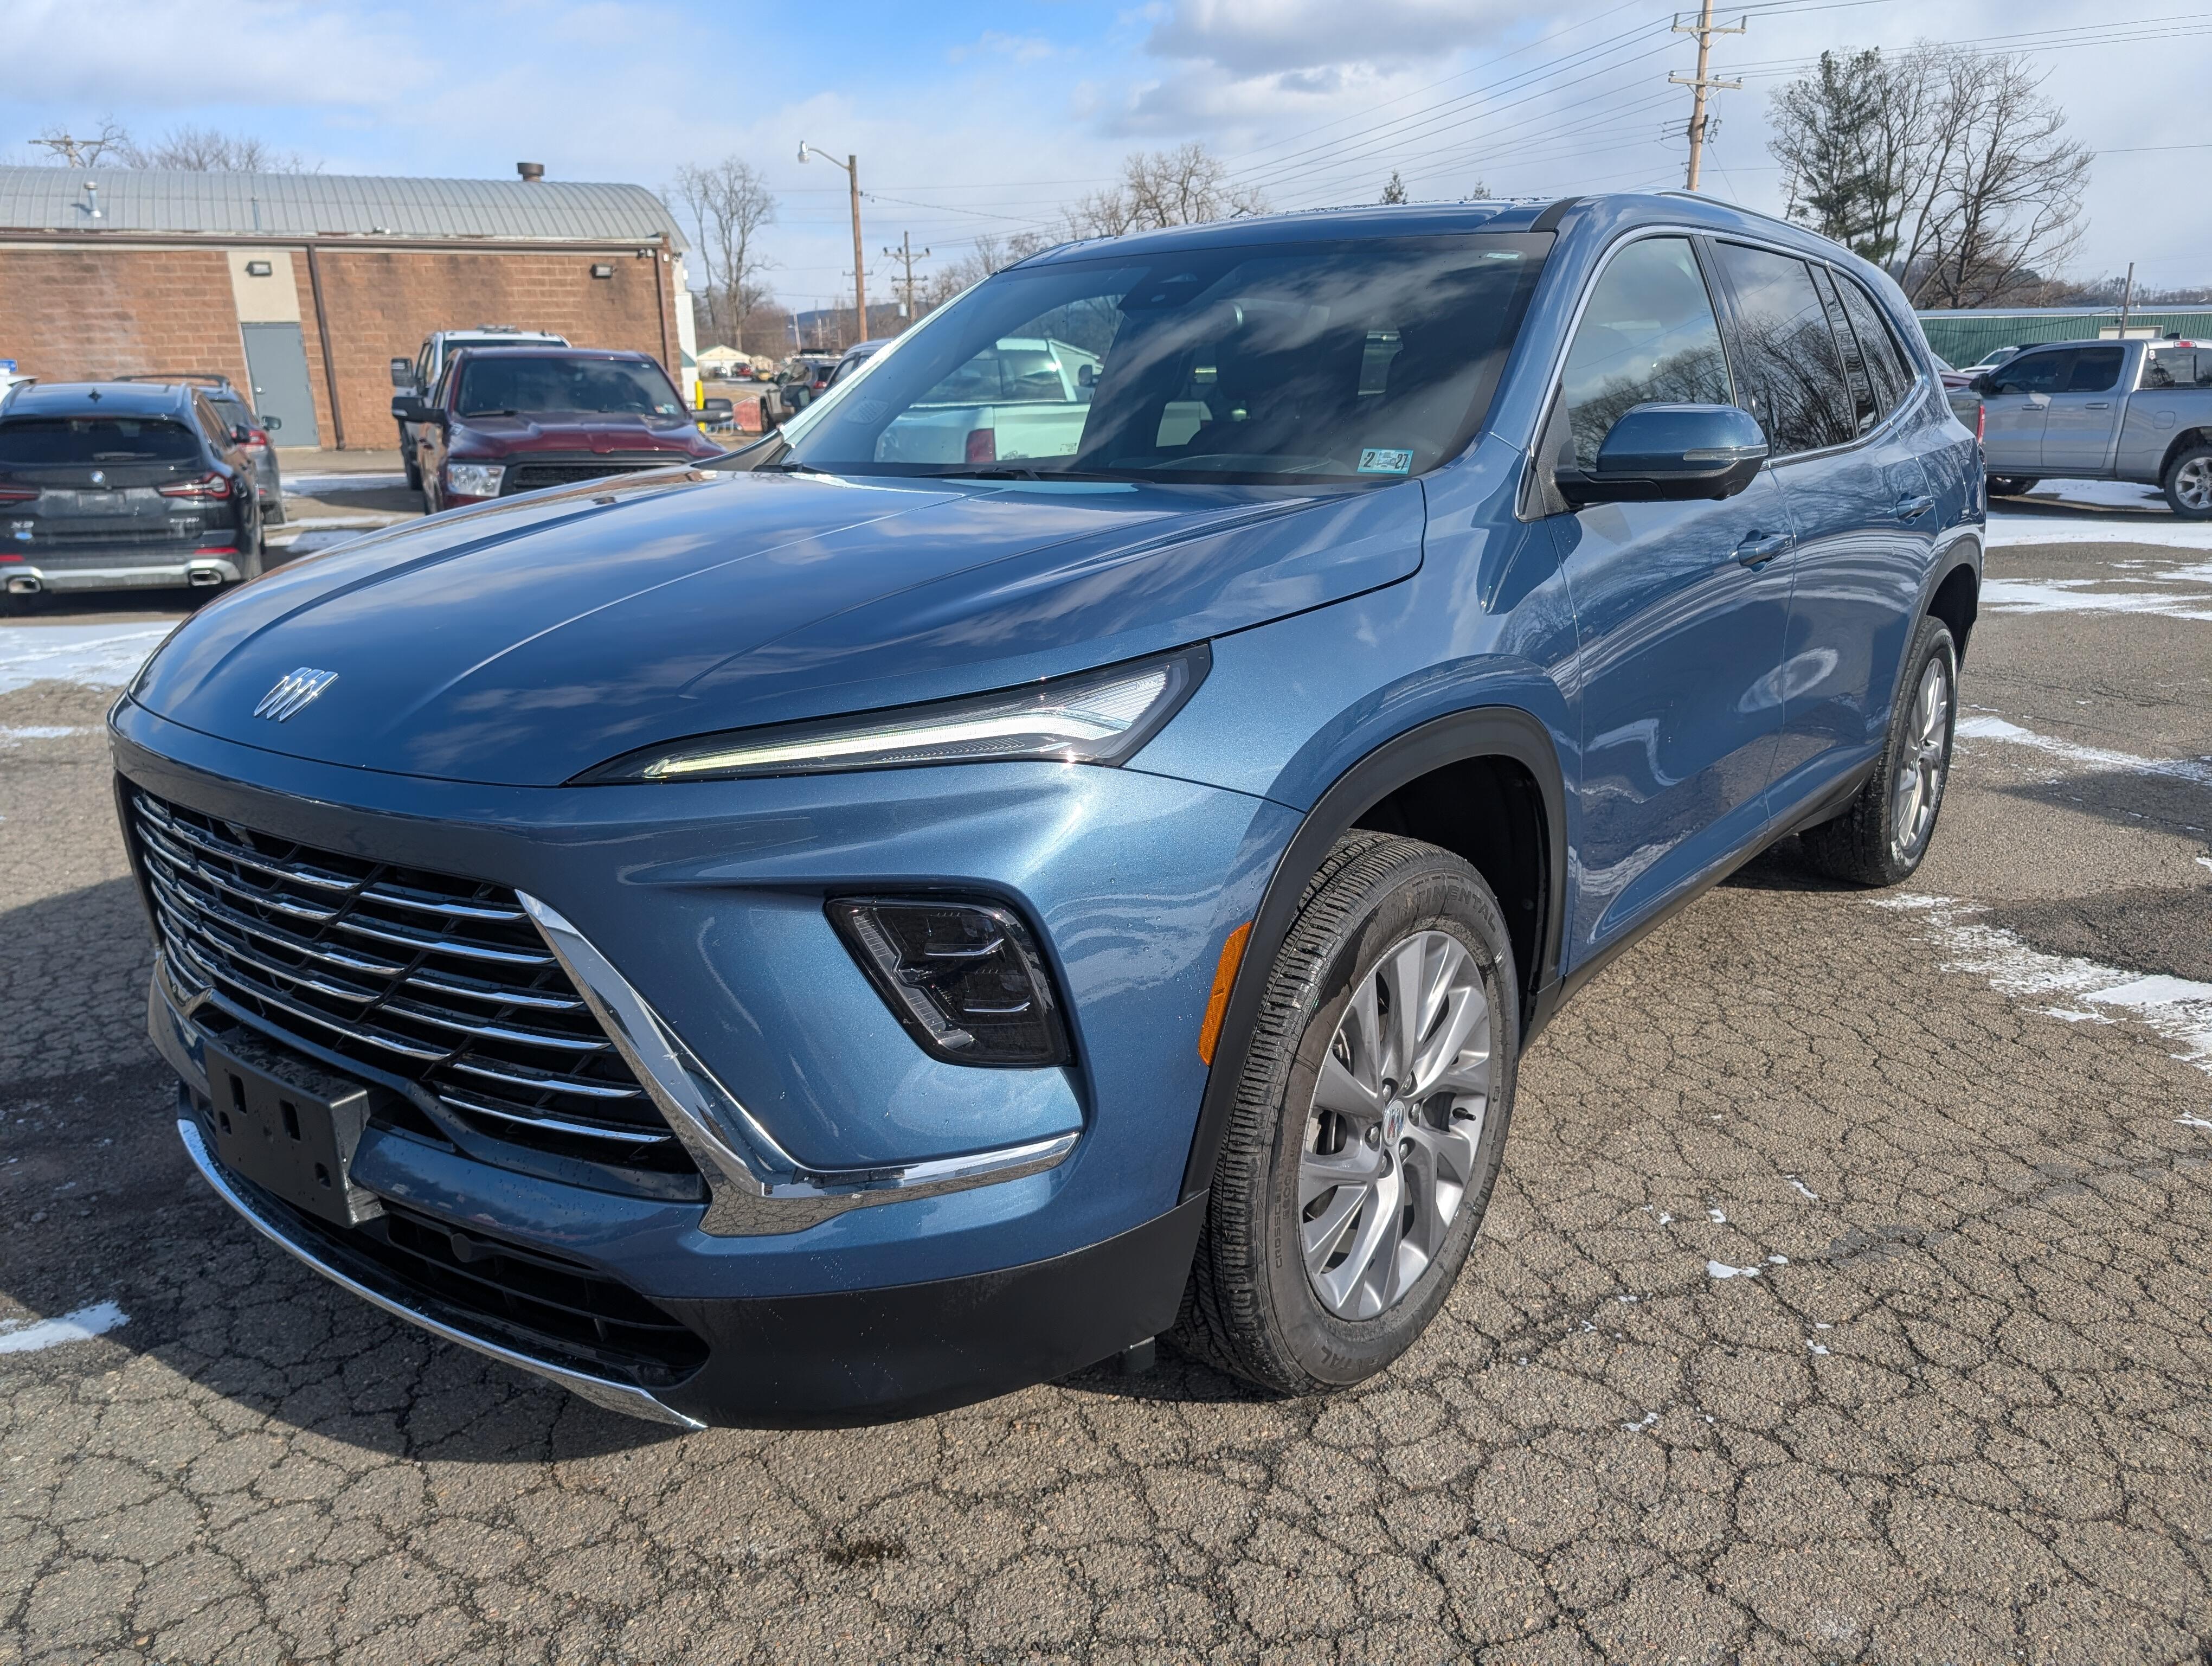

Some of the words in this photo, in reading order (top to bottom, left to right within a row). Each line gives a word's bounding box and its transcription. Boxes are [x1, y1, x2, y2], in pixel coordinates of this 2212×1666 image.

[1364, 452, 1375, 467] 2
[1394, 454, 1409, 470] 27
[1274, 1140, 1288, 1268] CROSSCONTA
